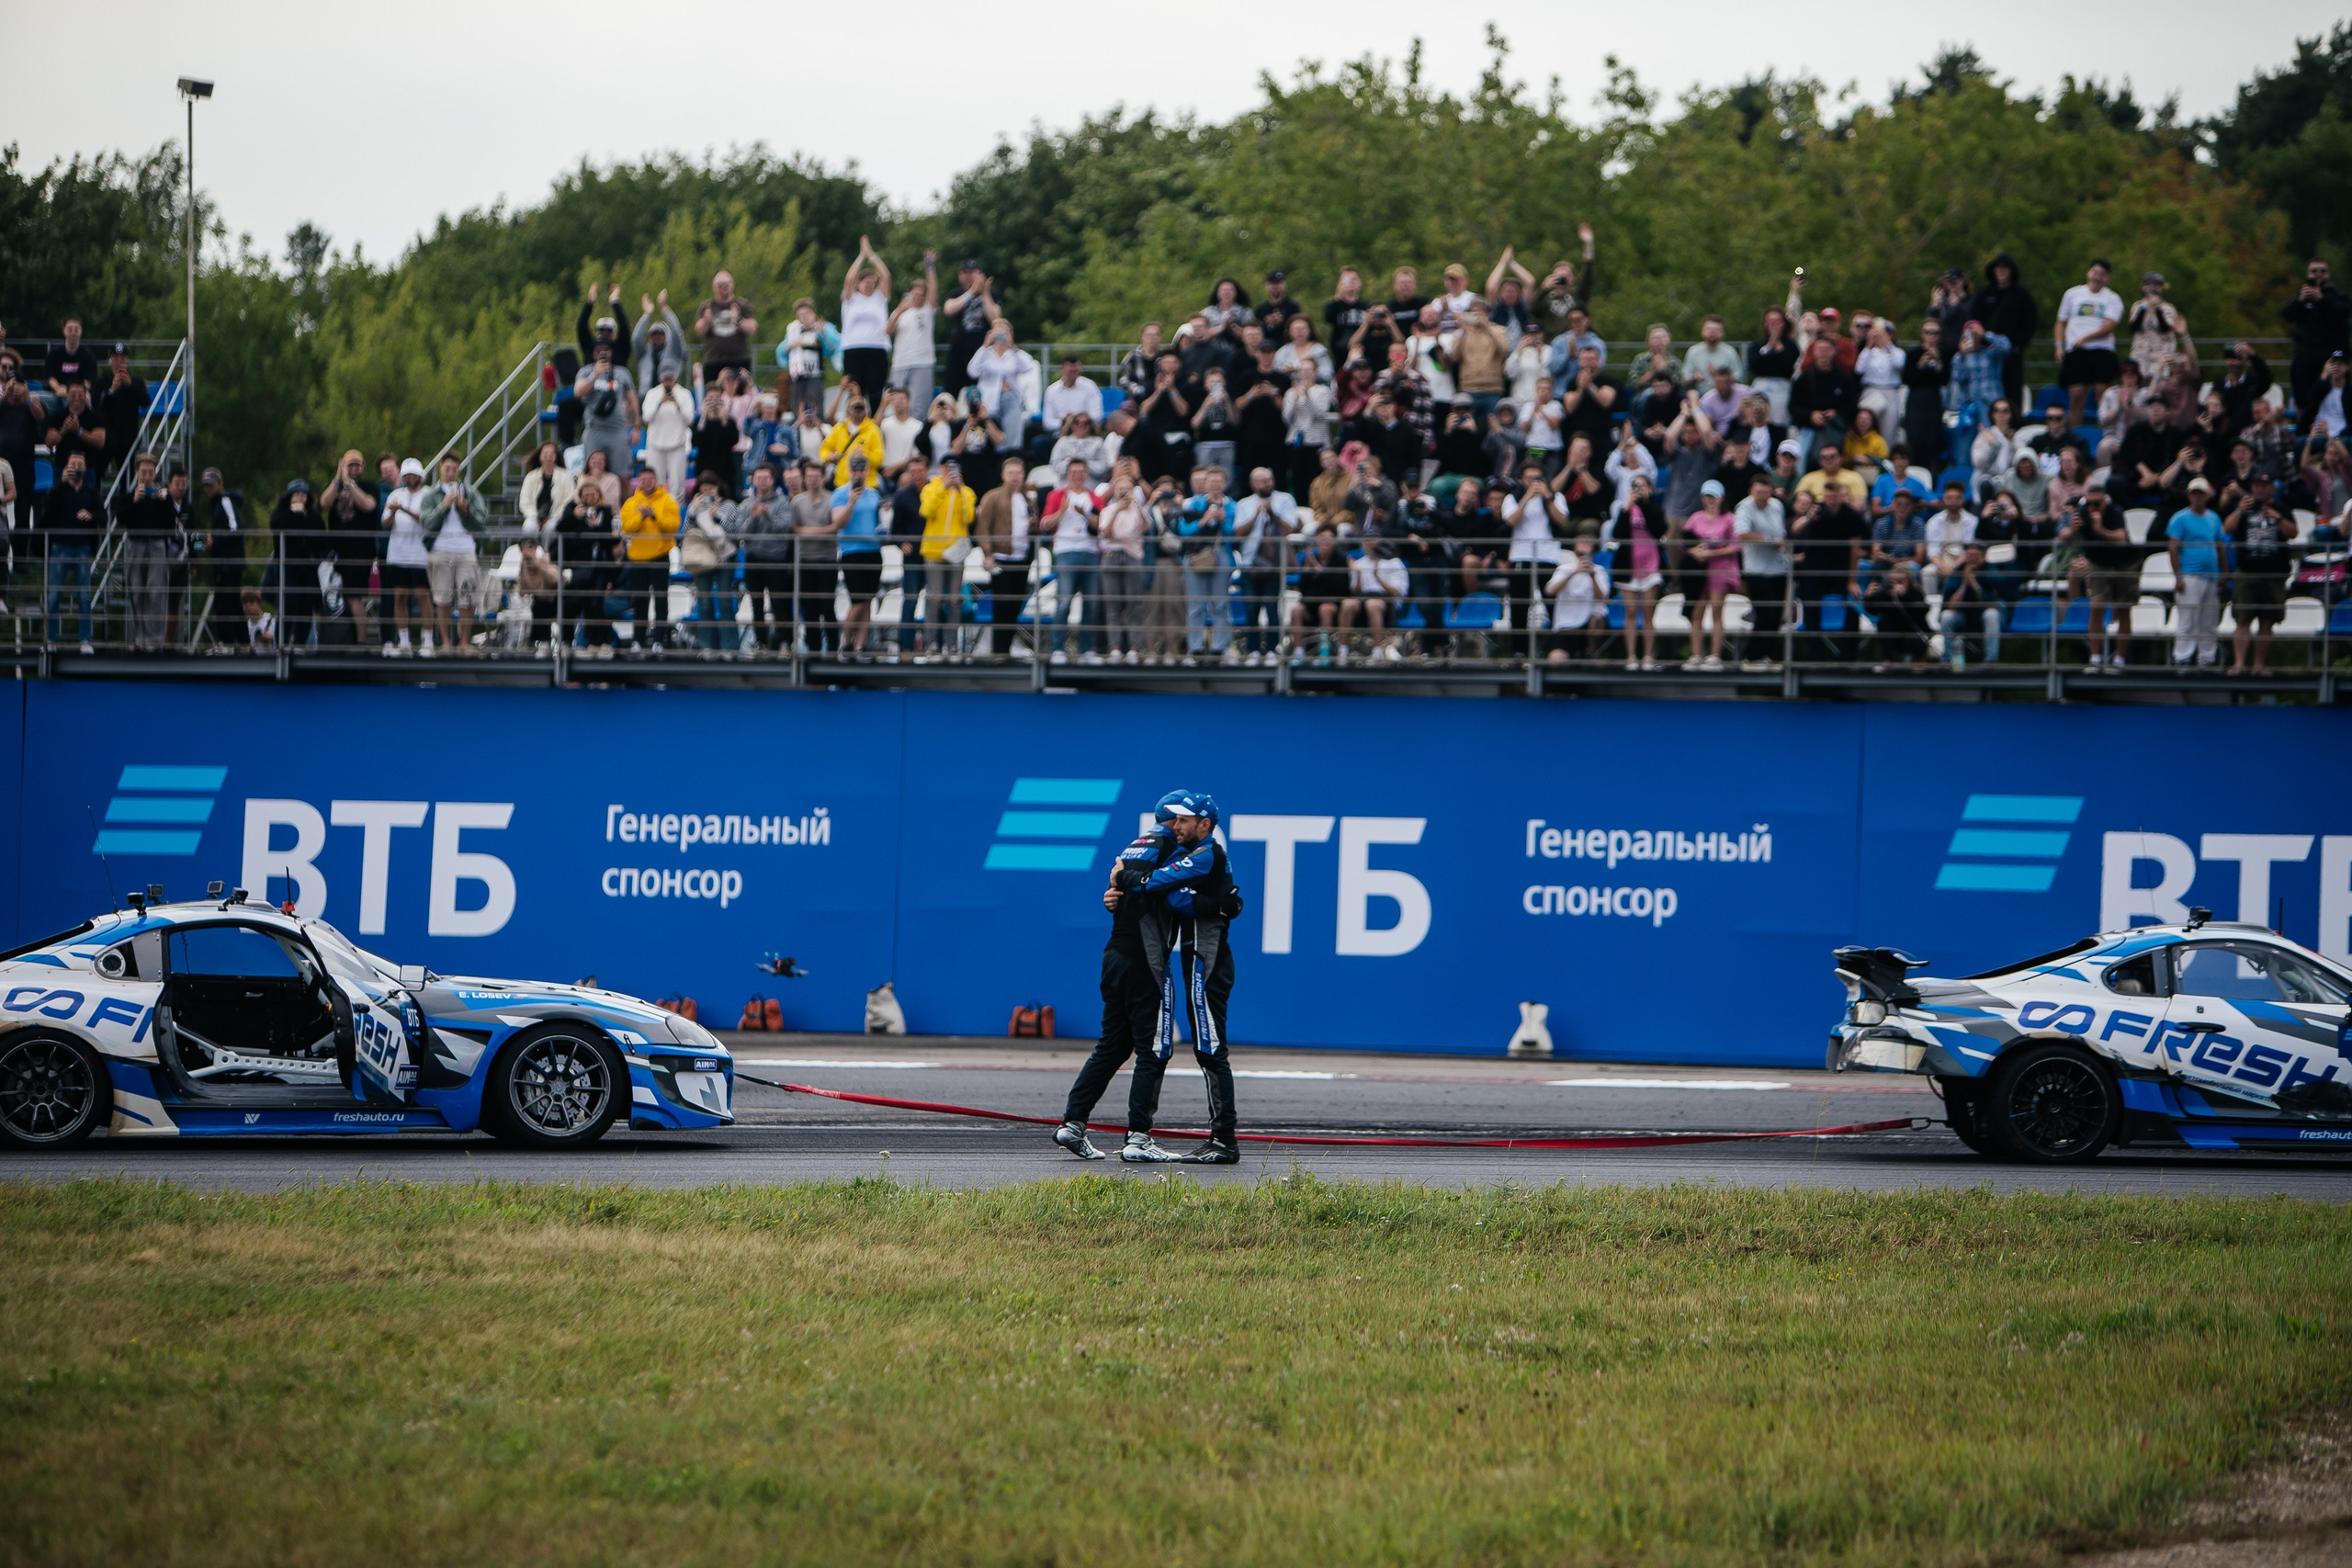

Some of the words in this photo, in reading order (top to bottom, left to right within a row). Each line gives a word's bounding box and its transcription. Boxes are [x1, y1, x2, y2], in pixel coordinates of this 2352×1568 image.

[606, 804, 831, 853] Генеральный
[1526, 818, 1772, 869] Генеральный
[239, 798, 516, 936] ВТБ
[602, 867, 743, 909] спонсор
[1138, 813, 1431, 956] ТБ
[1522, 885, 1678, 928] спонсор
[471, 991, 511, 999] LOSEV
[406, 1008, 420, 1027] ВТБ
[1163, 1011, 1171, 1045] RACING
[334, 1112, 404, 1122] freshauto.ru
[2300, 1129, 2352, 1140] freshaut
